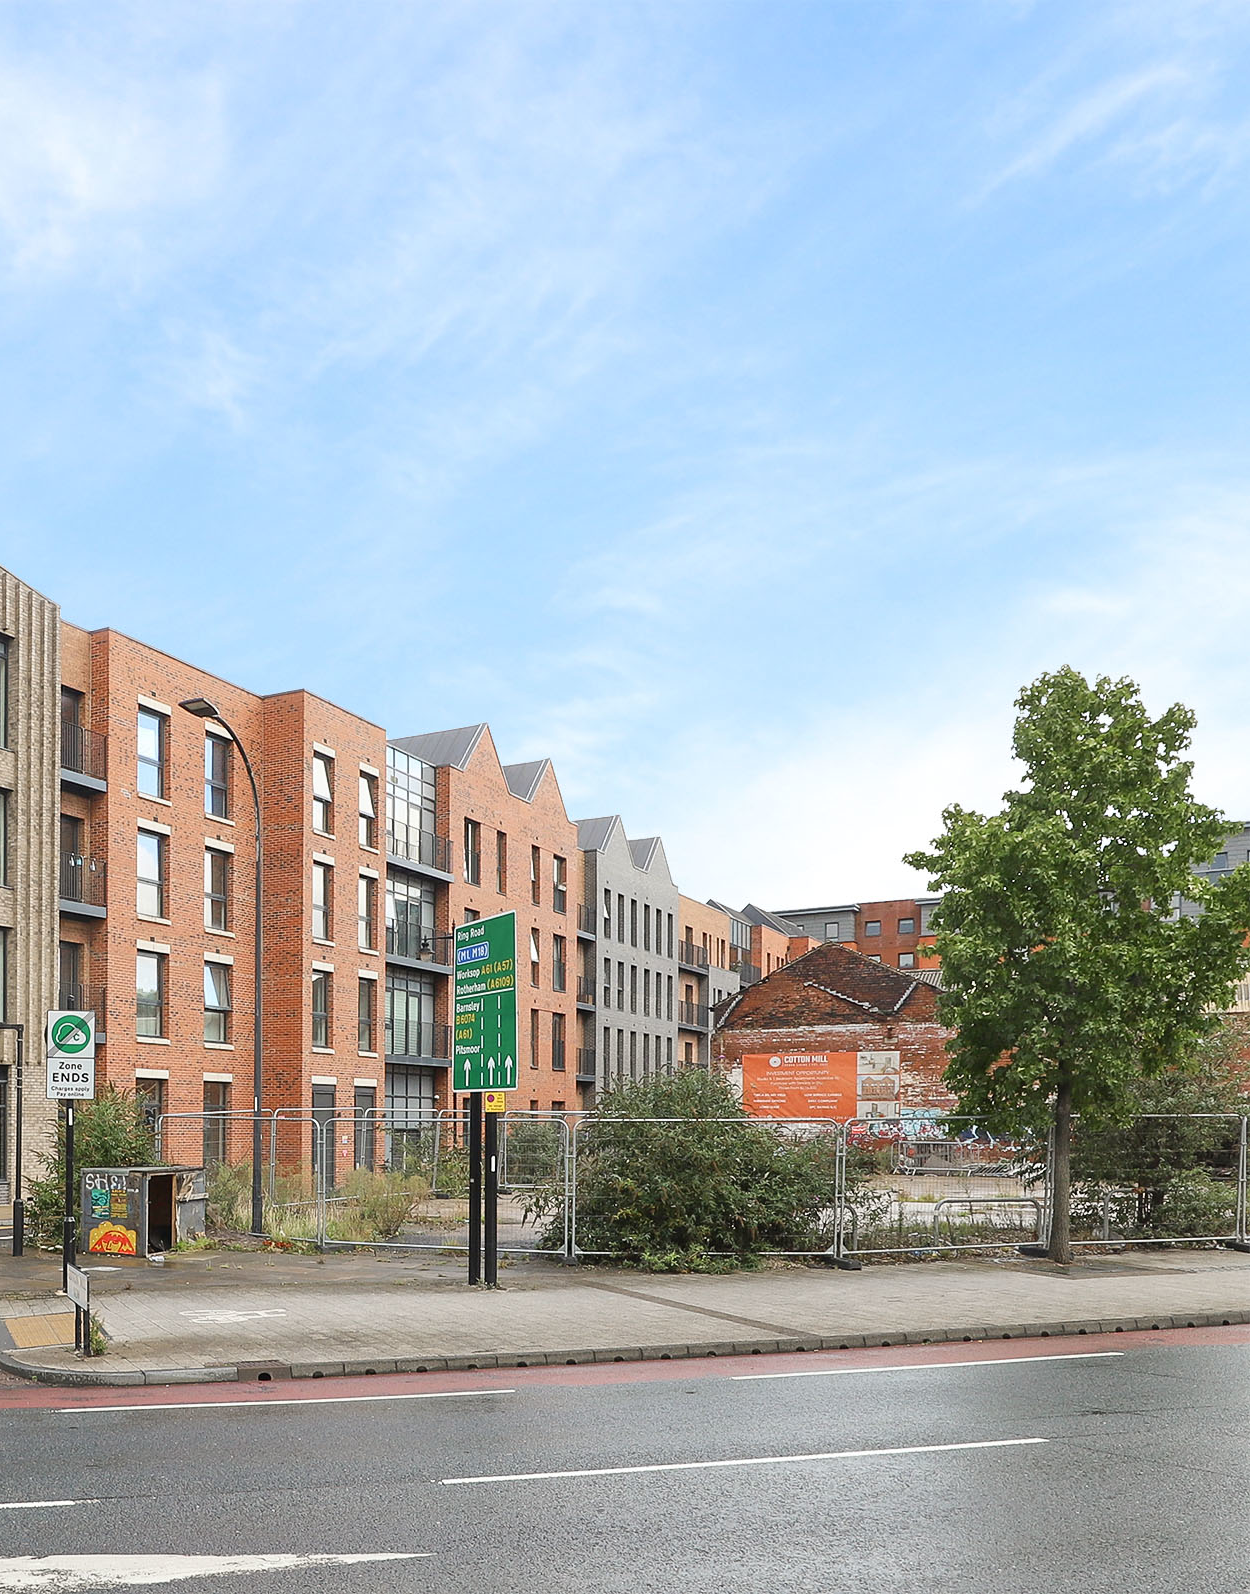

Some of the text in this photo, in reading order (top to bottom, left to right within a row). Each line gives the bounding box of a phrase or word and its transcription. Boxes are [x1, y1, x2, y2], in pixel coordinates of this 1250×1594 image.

[457, 925, 485, 941] Ring Road
[472, 944, 488, 958] M18)
[457, 958, 513, 980] Worksop A61 (A57)
[457, 974, 514, 996] Rotherham (A6109)
[456, 1001, 480, 1013] Barnsley
[456, 1027, 472, 1041] (A61)
[456, 1045, 480, 1055] Pitsmoor
[59, 1062, 82, 1070] Zone
[784, 1055, 828, 1064] COTTON MILL
[52, 1073, 89, 1083] ENDS
